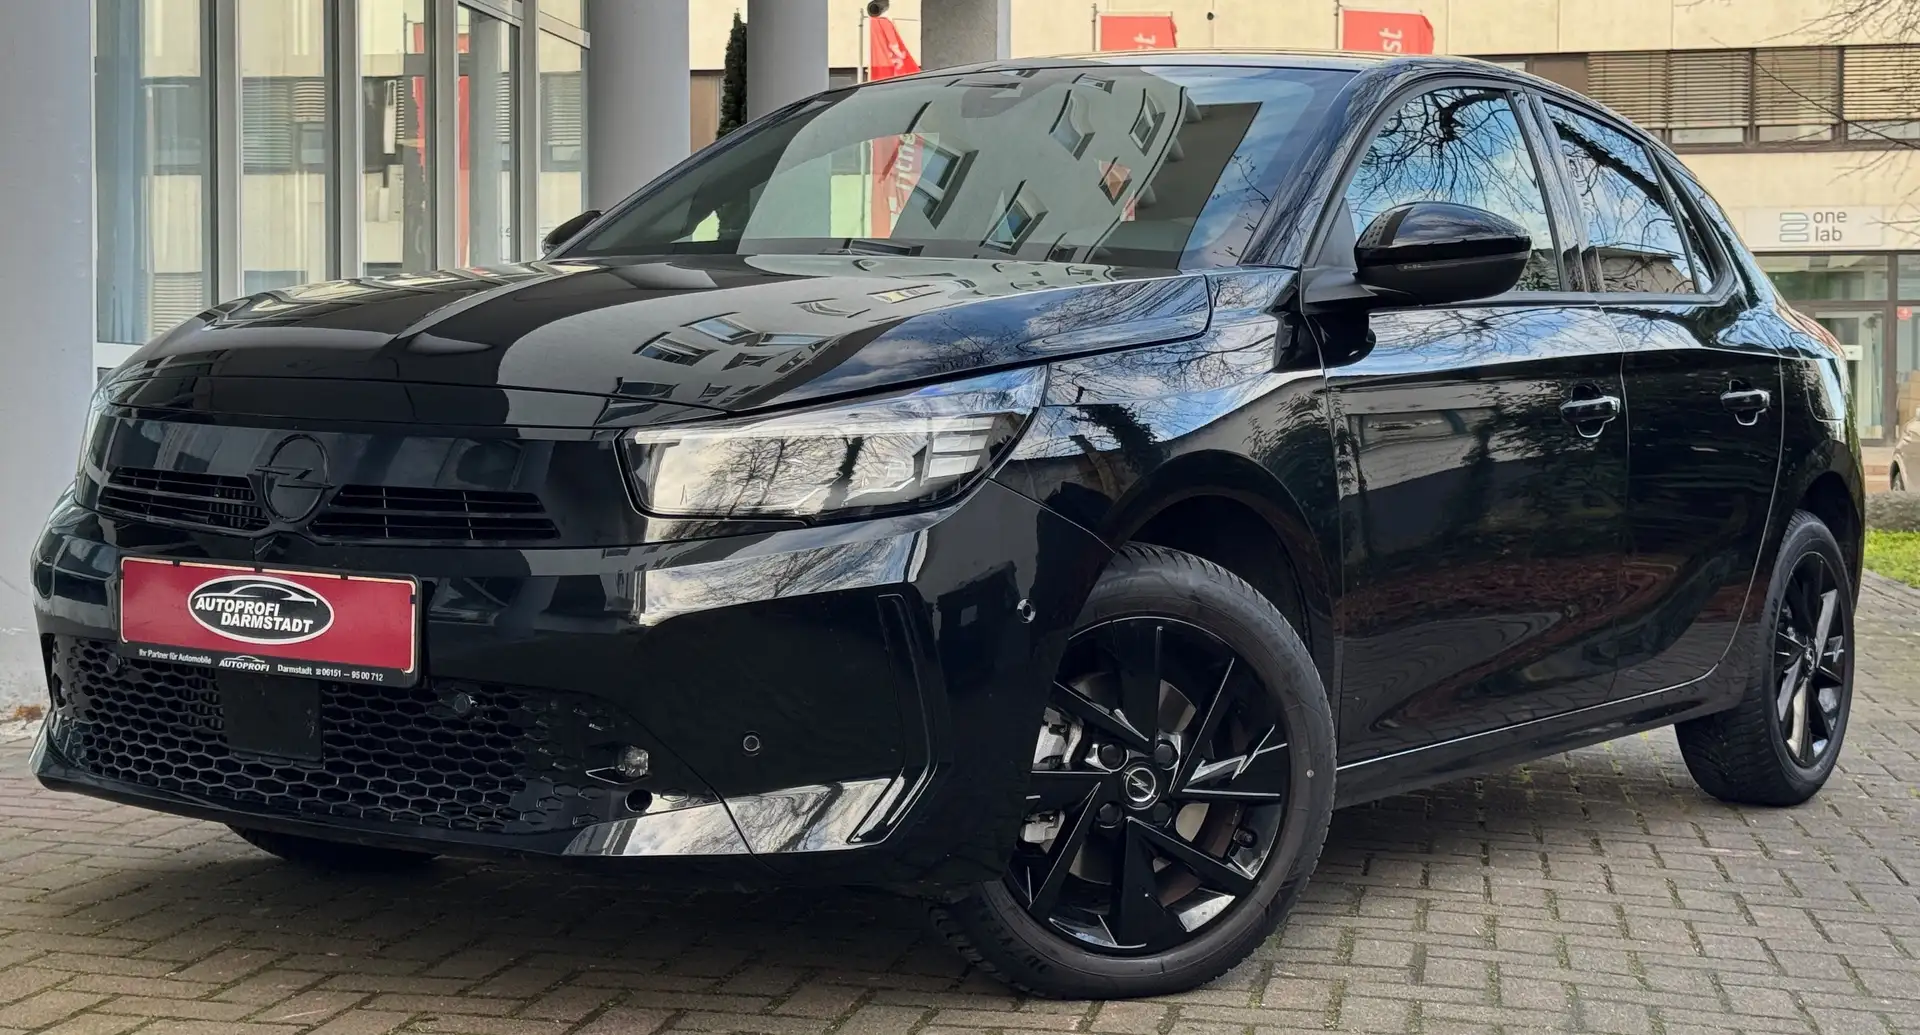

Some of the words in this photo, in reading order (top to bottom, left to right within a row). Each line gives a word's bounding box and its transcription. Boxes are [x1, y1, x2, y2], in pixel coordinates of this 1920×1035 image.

[1813, 211, 1847, 224] one
[1815, 226, 1842, 242] lab
[195, 597, 280, 617] AUTOPROFI
[221, 612, 314, 633] DARMSTADT
[139, 648, 147, 657] Ihr
[147, 649, 168, 659] Partner
[169, 652, 179, 661] für
[178, 653, 212, 665] Automobile
[219, 659, 270, 672] AUTOPROFI
[277, 664, 313, 675] Darmstadt
[351, 670, 360, 679] 95
[361, 671, 370, 680] 00
[370, 672, 384, 682] 712
